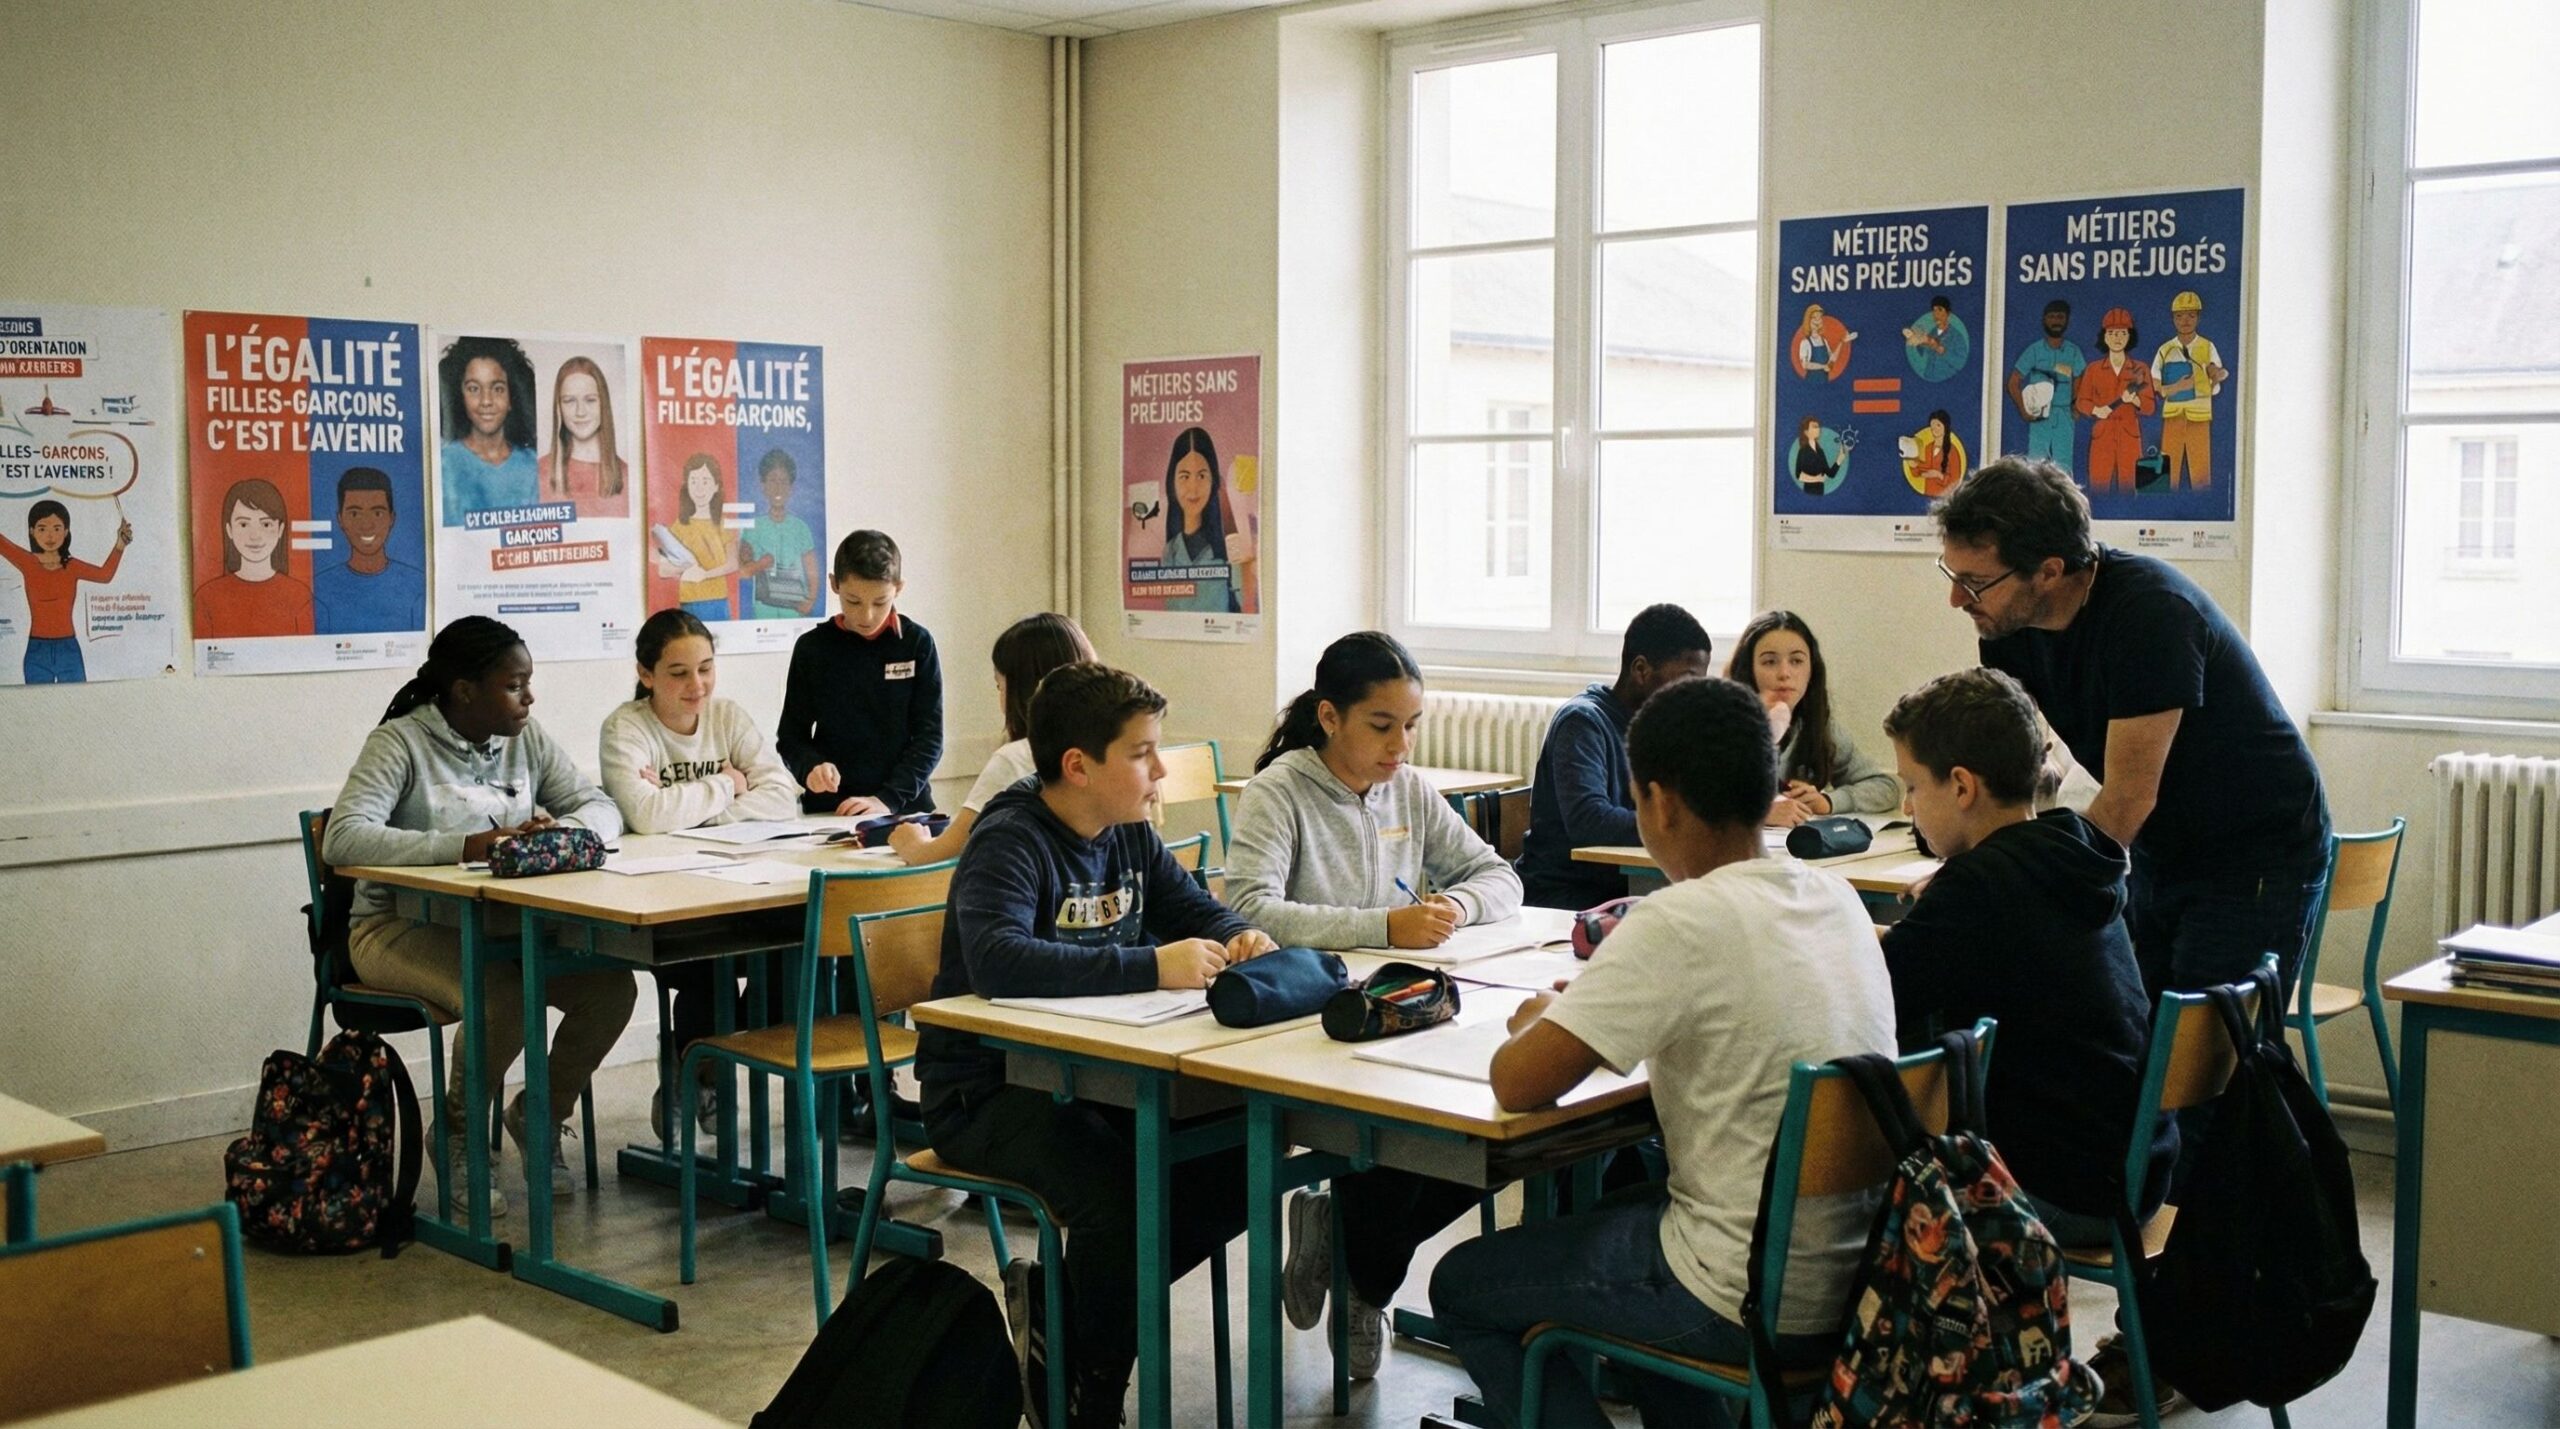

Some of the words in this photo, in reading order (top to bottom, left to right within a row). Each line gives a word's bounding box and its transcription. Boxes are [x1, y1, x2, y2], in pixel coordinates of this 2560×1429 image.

[1834, 222, 1928, 256] MÉTIERS
[2068, 207, 2175, 243] MÉTIERS
[1792, 264, 1848, 293] SANS
[1856, 251, 1972, 290] PRÉJUGÉS
[2020, 252, 2085, 282] SANS
[2094, 237, 2225, 279] PRÉJUGÉS
[206, 324, 402, 386] L'ÉGALITÉ
[658, 347, 809, 401] L'ÉGALITÉ
[1130, 371, 1191, 396] MÉTIERS
[1196, 369, 1237, 393] SANS
[208, 387, 403, 422] FILLES-GARÇONS,
[658, 401, 811, 432] FILLES-GARÇONS,
[1130, 397, 1203, 424] PRÉJUGÉS
[208, 420, 284, 451] C'EST
[293, 422, 403, 453] L'AVENIR
[506, 527, 559, 546] GARÇONS
